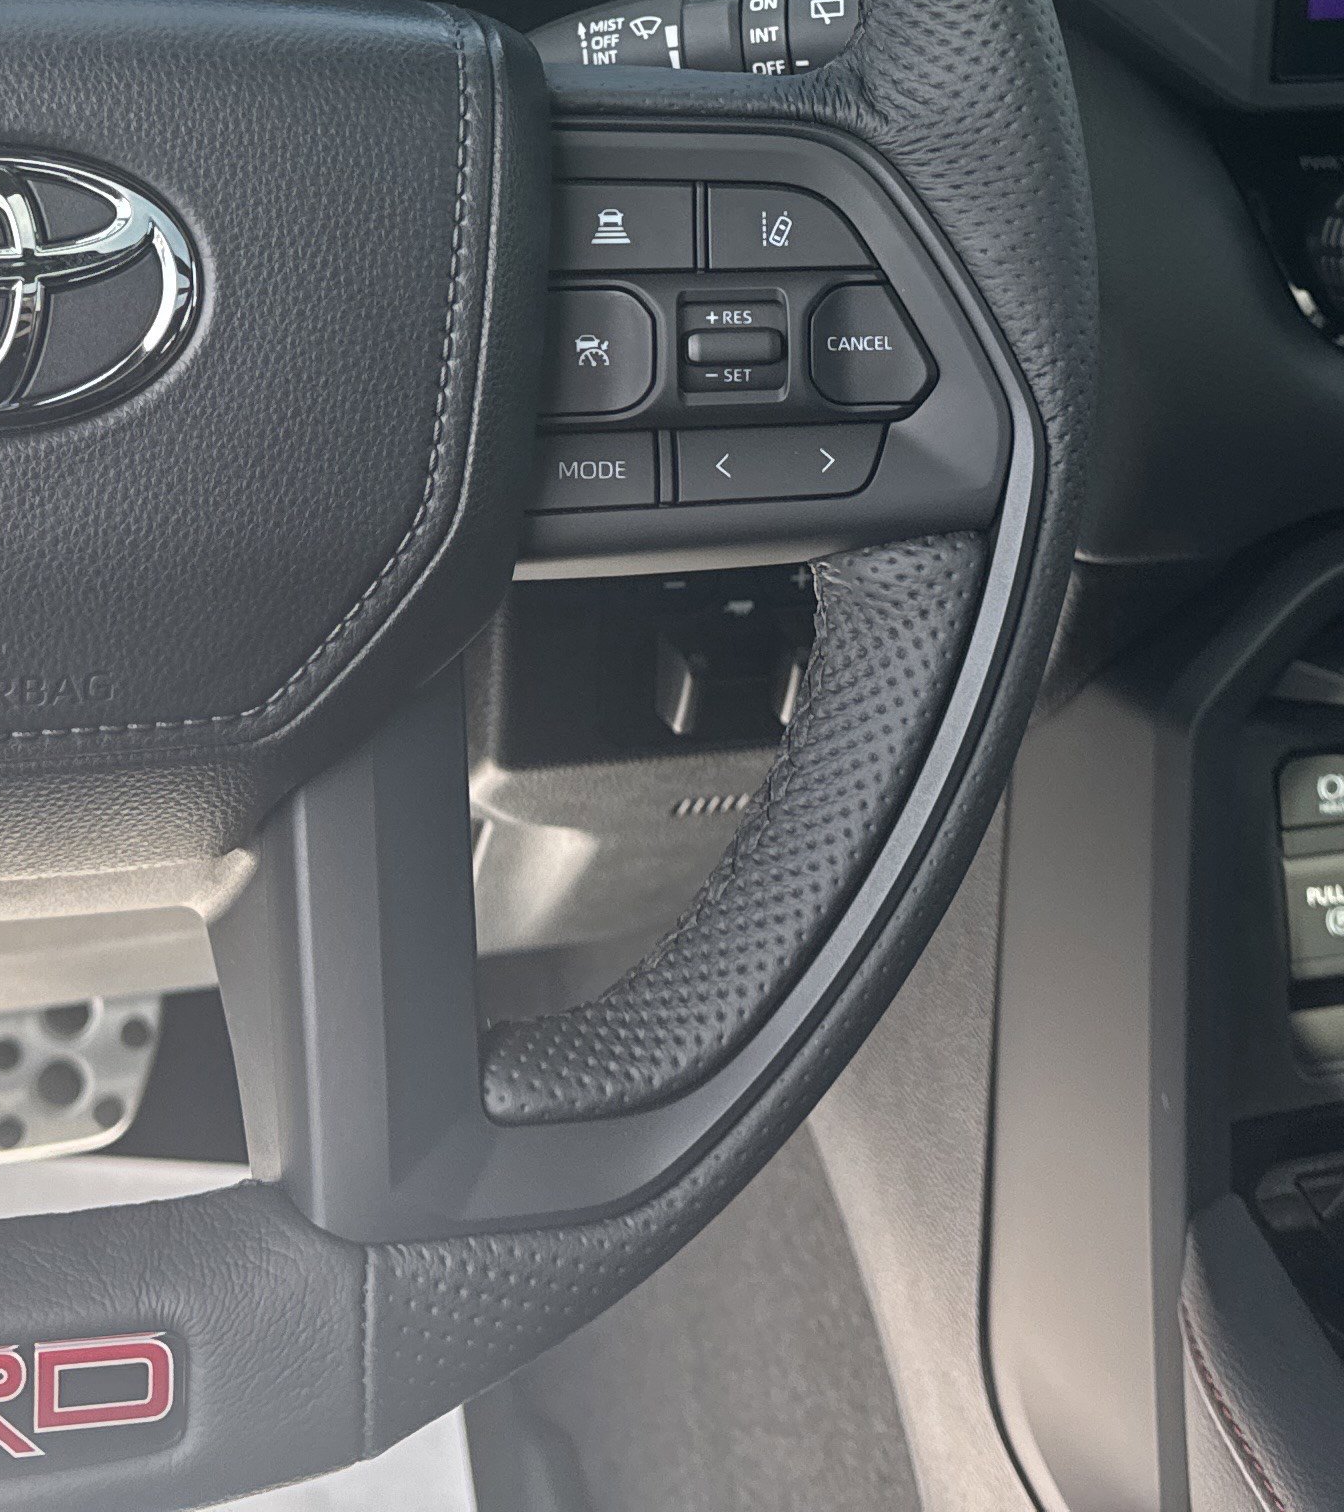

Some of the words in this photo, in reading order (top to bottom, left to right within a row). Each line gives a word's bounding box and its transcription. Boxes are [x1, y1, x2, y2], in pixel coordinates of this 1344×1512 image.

[589, 17, 625, 32] MIST
[590, 34, 621, 49] OFF
[749, 25, 779, 43] INT
[592, 50, 619, 65] INT
[752, 59, 786, 76] OFF
[826, 335, 893, 353] CANCEL
[558, 460, 627, 480] MODE
